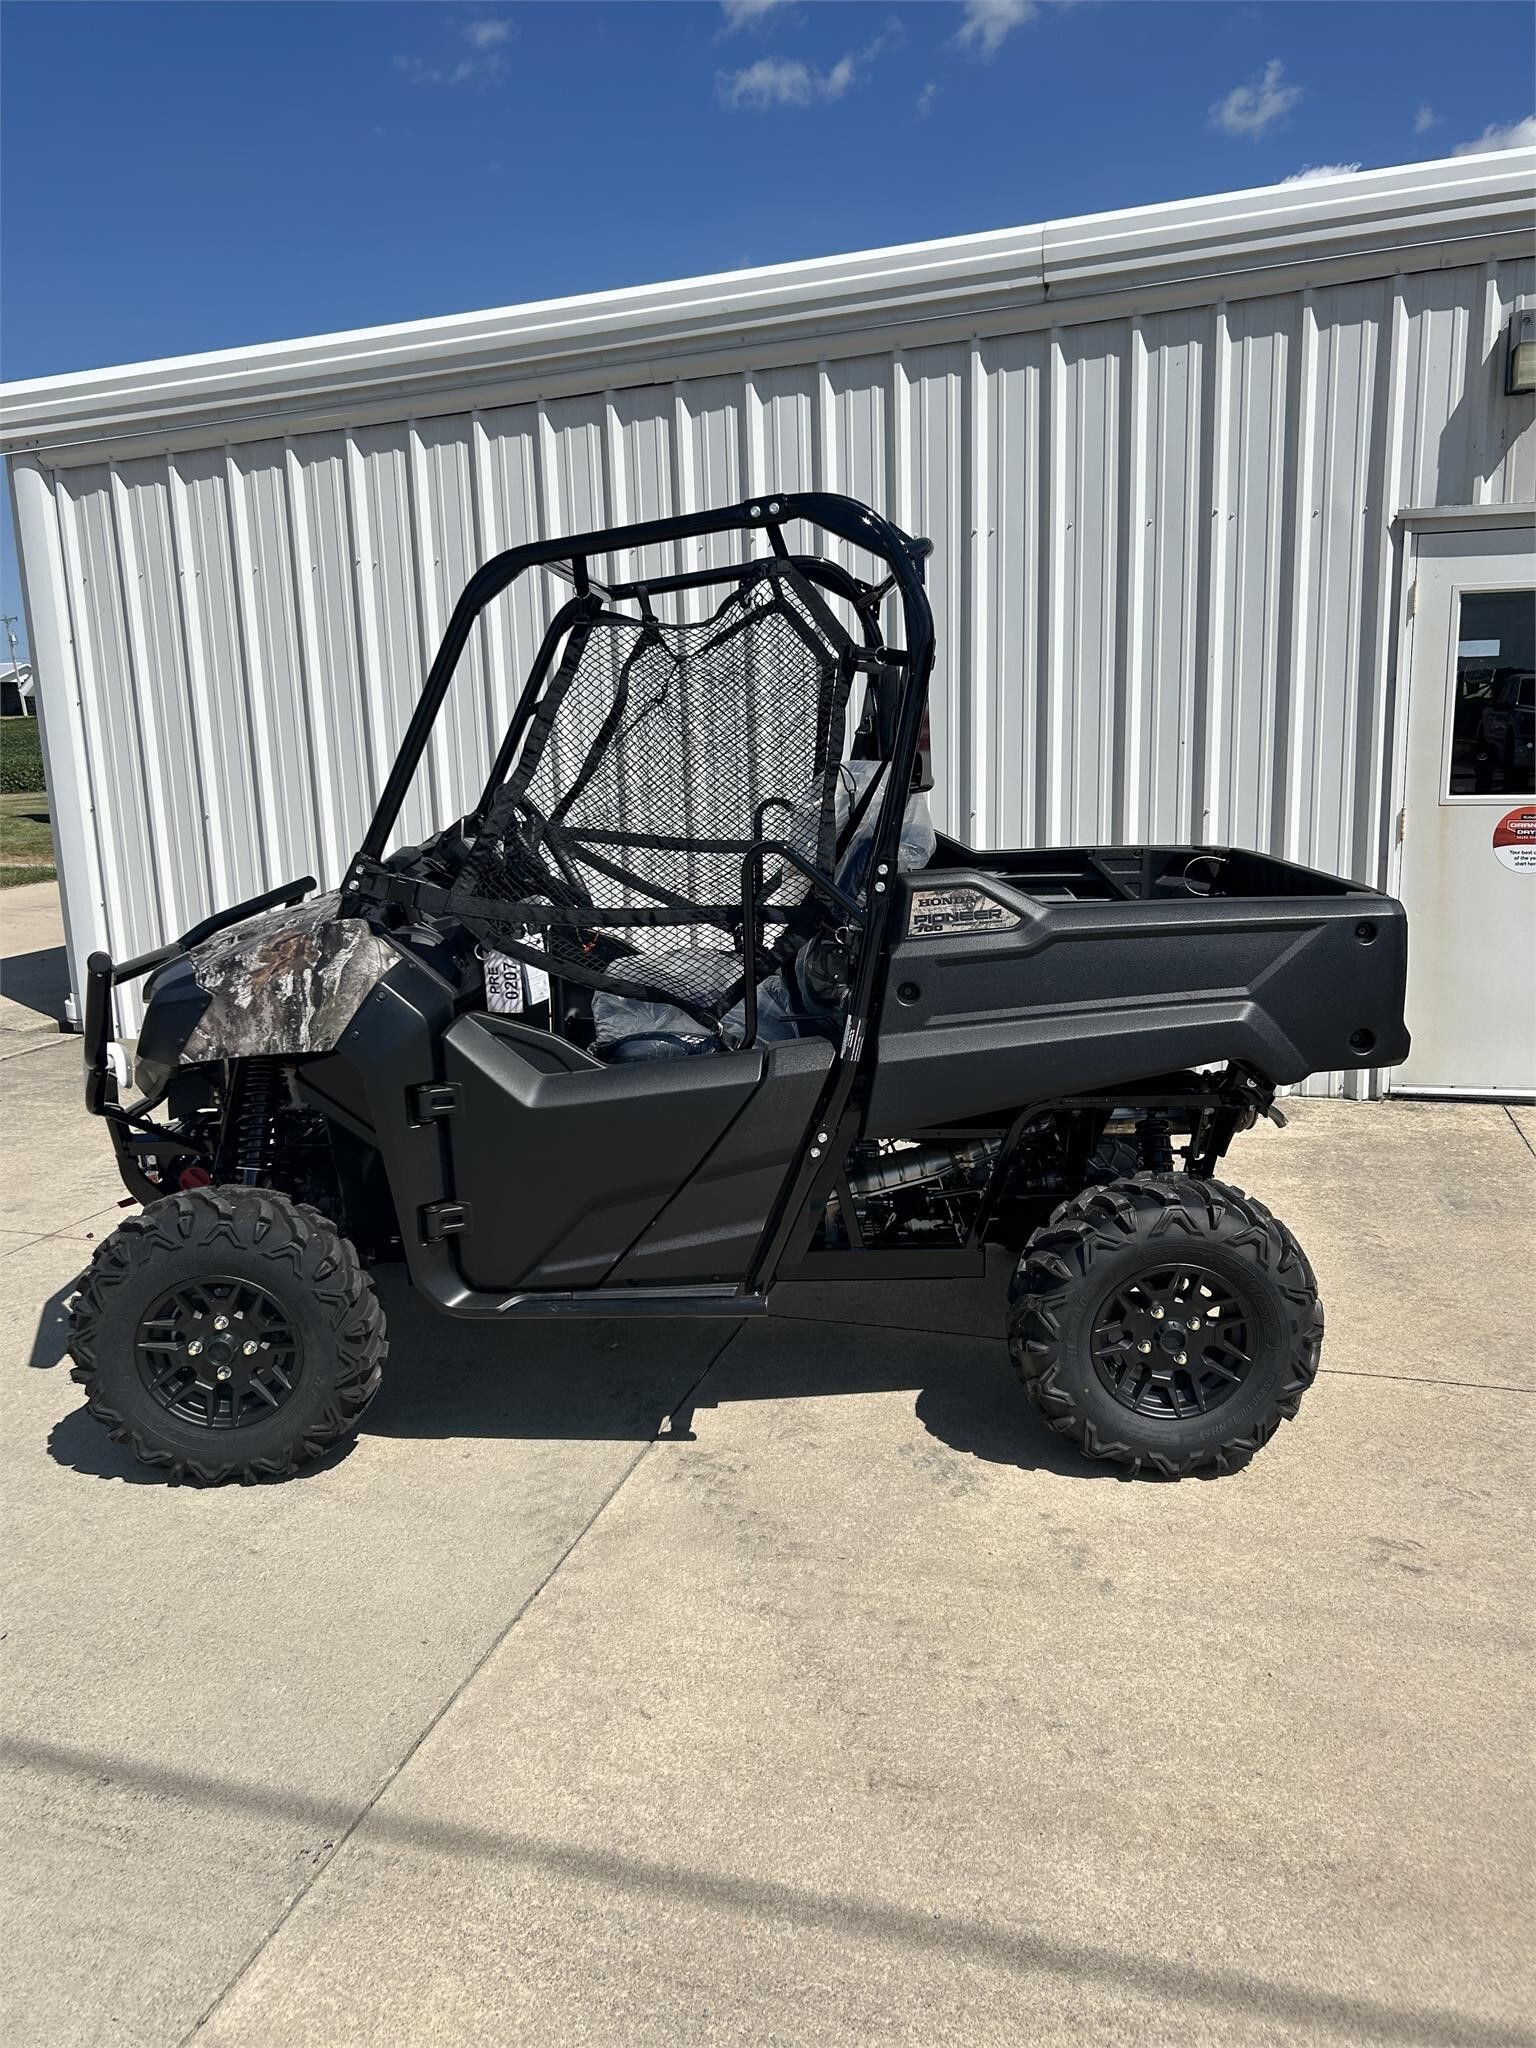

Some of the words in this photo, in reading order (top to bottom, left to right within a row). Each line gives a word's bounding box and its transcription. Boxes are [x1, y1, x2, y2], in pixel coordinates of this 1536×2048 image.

[918, 896, 977, 907] HONDA
[914, 909, 1002, 924] PIONEER
[913, 924, 943, 932] 700
[488, 966, 500, 994] PRE
[503, 962, 518, 1000] 0207
